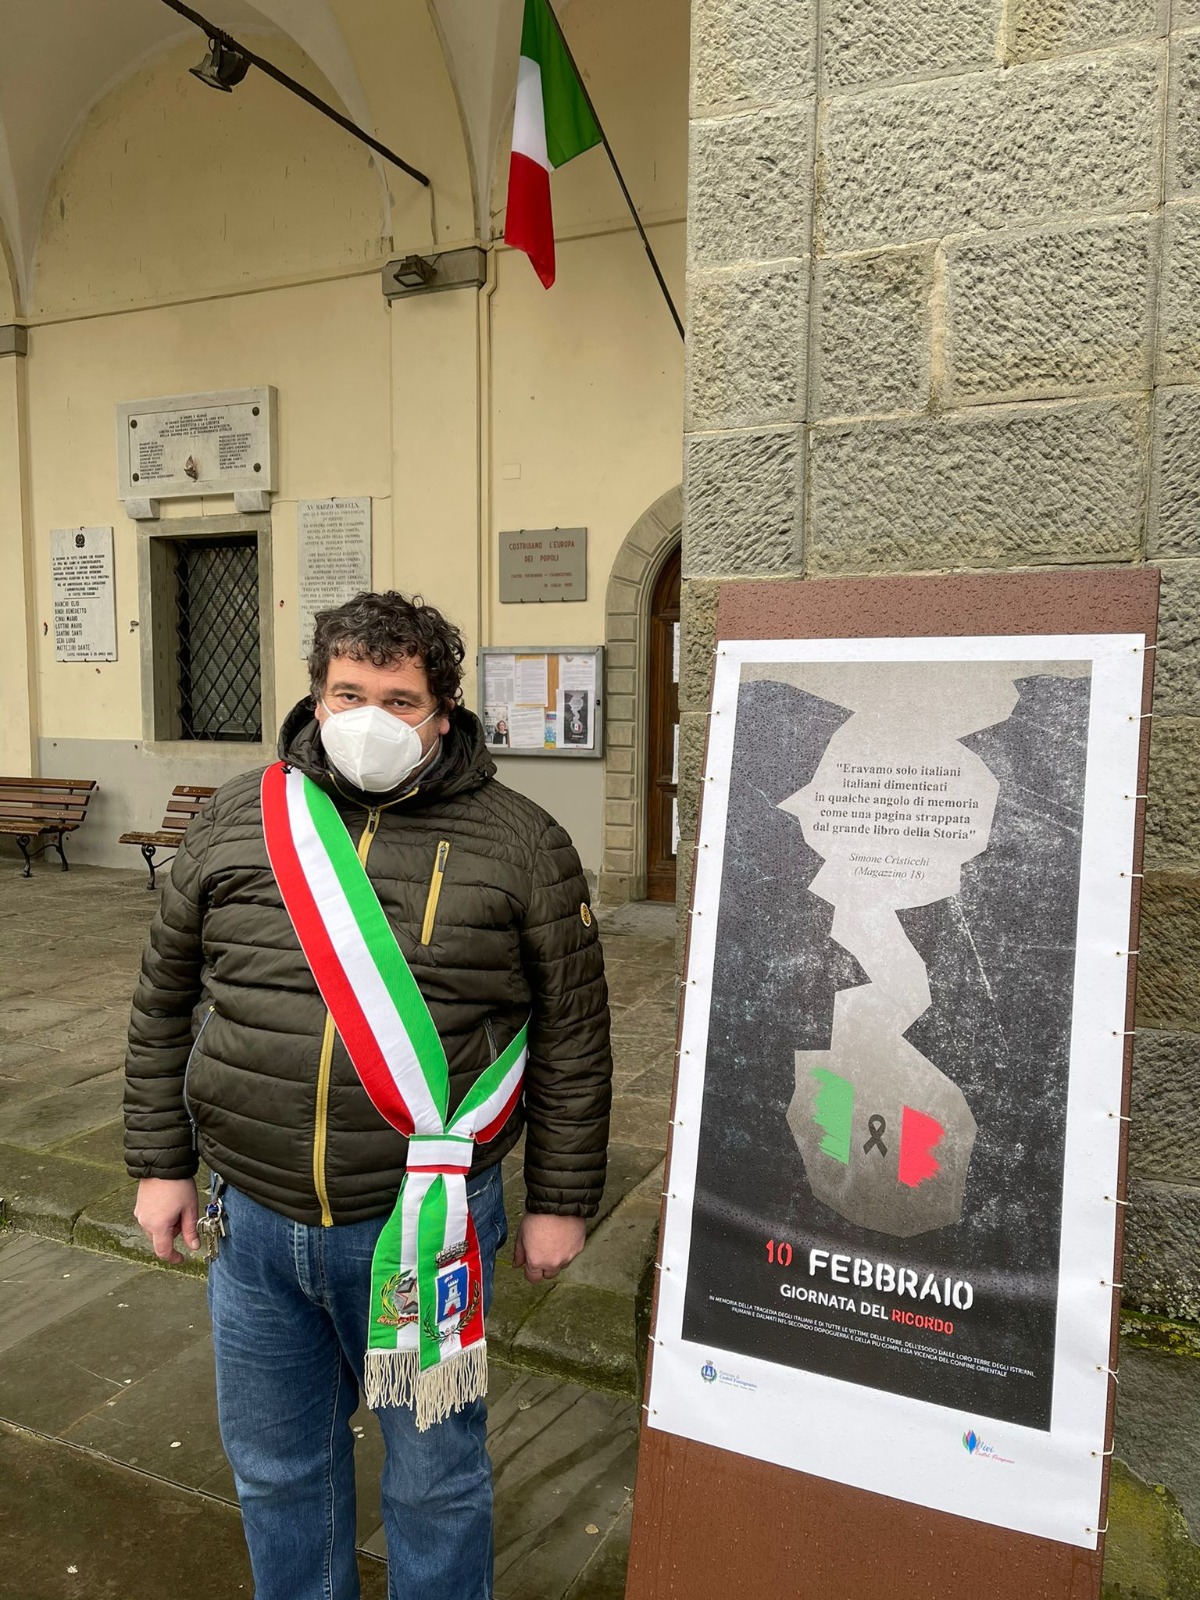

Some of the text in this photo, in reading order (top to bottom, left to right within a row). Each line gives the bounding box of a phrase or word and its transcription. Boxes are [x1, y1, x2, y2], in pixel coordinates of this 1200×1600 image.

[509, 540, 575, 550] COSTRUIAMO L'EUROPA
[836, 763, 961, 777] "Eravamo solo italiani
[843, 778, 948, 792] italiani dimenticati
[815, 792, 979, 809] in qualche angolo di memoria
[820, 809, 970, 826] come una pagina strappata
[813, 822, 976, 840] dal grande libro della Storia"
[849, 852, 930, 866] Simone Cristicchi
[854, 866, 925, 880] (Magazzino 18)
[766, 1239, 974, 1310] 10 FEBBRAIO
[780, 1284, 954, 1335] GIORNATA DEL RICORDO
[715, 1297, 738, 1306] MEMORIA
[754, 1305, 777, 1315] TRAGEDIA
[778, 1311, 793, 1319] DEGLI
[794, 1315, 813, 1325] ITALIANI
[825, 1322, 841, 1331] TUTTE
[849, 1328, 869, 1338] VITTIME
[870, 1333, 886, 1342] DELLE
[904, 1341, 938, 1354] DELL'ESODO
[938, 1350, 955, 1358] DALLE
[956, 1354, 973, 1362] LORO
[973, 1357, 990, 1367] TERRE
[992, 1361, 1009, 1371] DEGLI
[732, 1307, 752, 1316] FIUMANI
[756, 1313, 777, 1322] DALMATI
[788, 1320, 813, 1331] SECONDO
[814, 1326, 849, 1339] DOPOGUERRA
[855, 1336, 871, 1345] DELLA
[881, 1342, 914, 1355] COMPLESSA
[914, 1350, 938, 1361] VICENDA
[950, 1359, 975, 1370] CONFINE
[976, 1365, 1007, 1377] ORIENTALE
